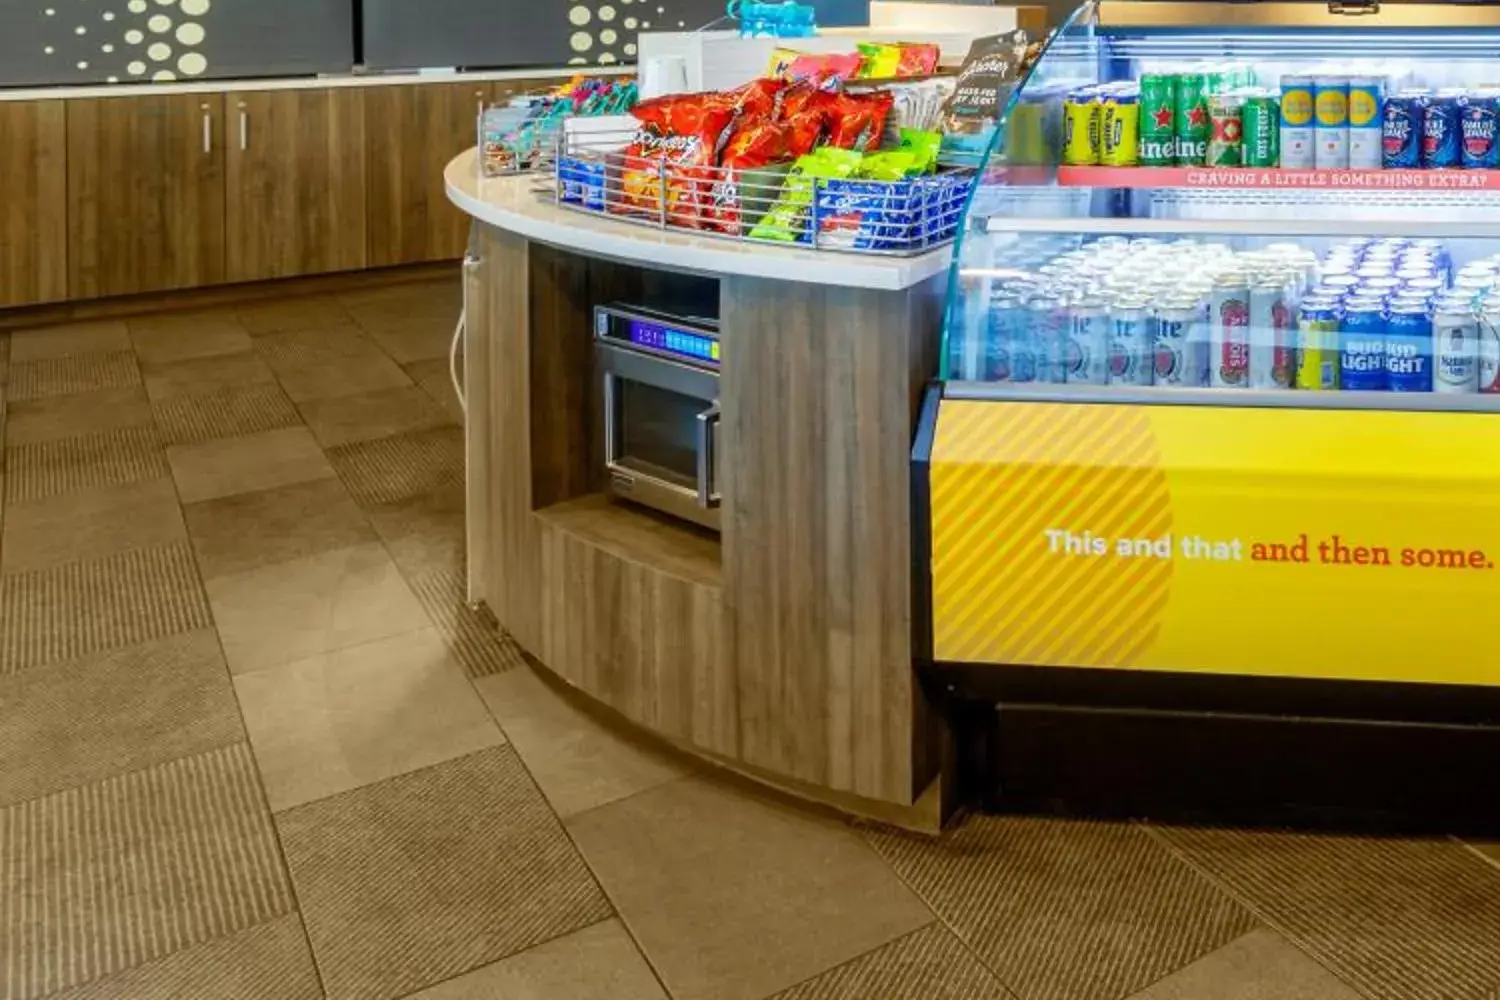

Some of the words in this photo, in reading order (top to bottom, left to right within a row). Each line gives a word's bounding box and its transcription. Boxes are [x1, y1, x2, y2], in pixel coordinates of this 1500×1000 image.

[1187, 172, 1256, 186] CRAVING
[1261, 173, 1272, 186] A
[1276, 173, 1327, 186] LITTLE
[1331, 173, 1424, 187] SOMETHING
[1429, 174, 1488, 188] EXTRA?
[1044, 529, 1107, 556] This
[1115, 533, 1172, 559] and
[1181, 535, 1242, 561] that
[1250, 533, 1310, 562] and
[1318, 535, 1391, 565] then
[1400, 547, 1494, 569] some.
